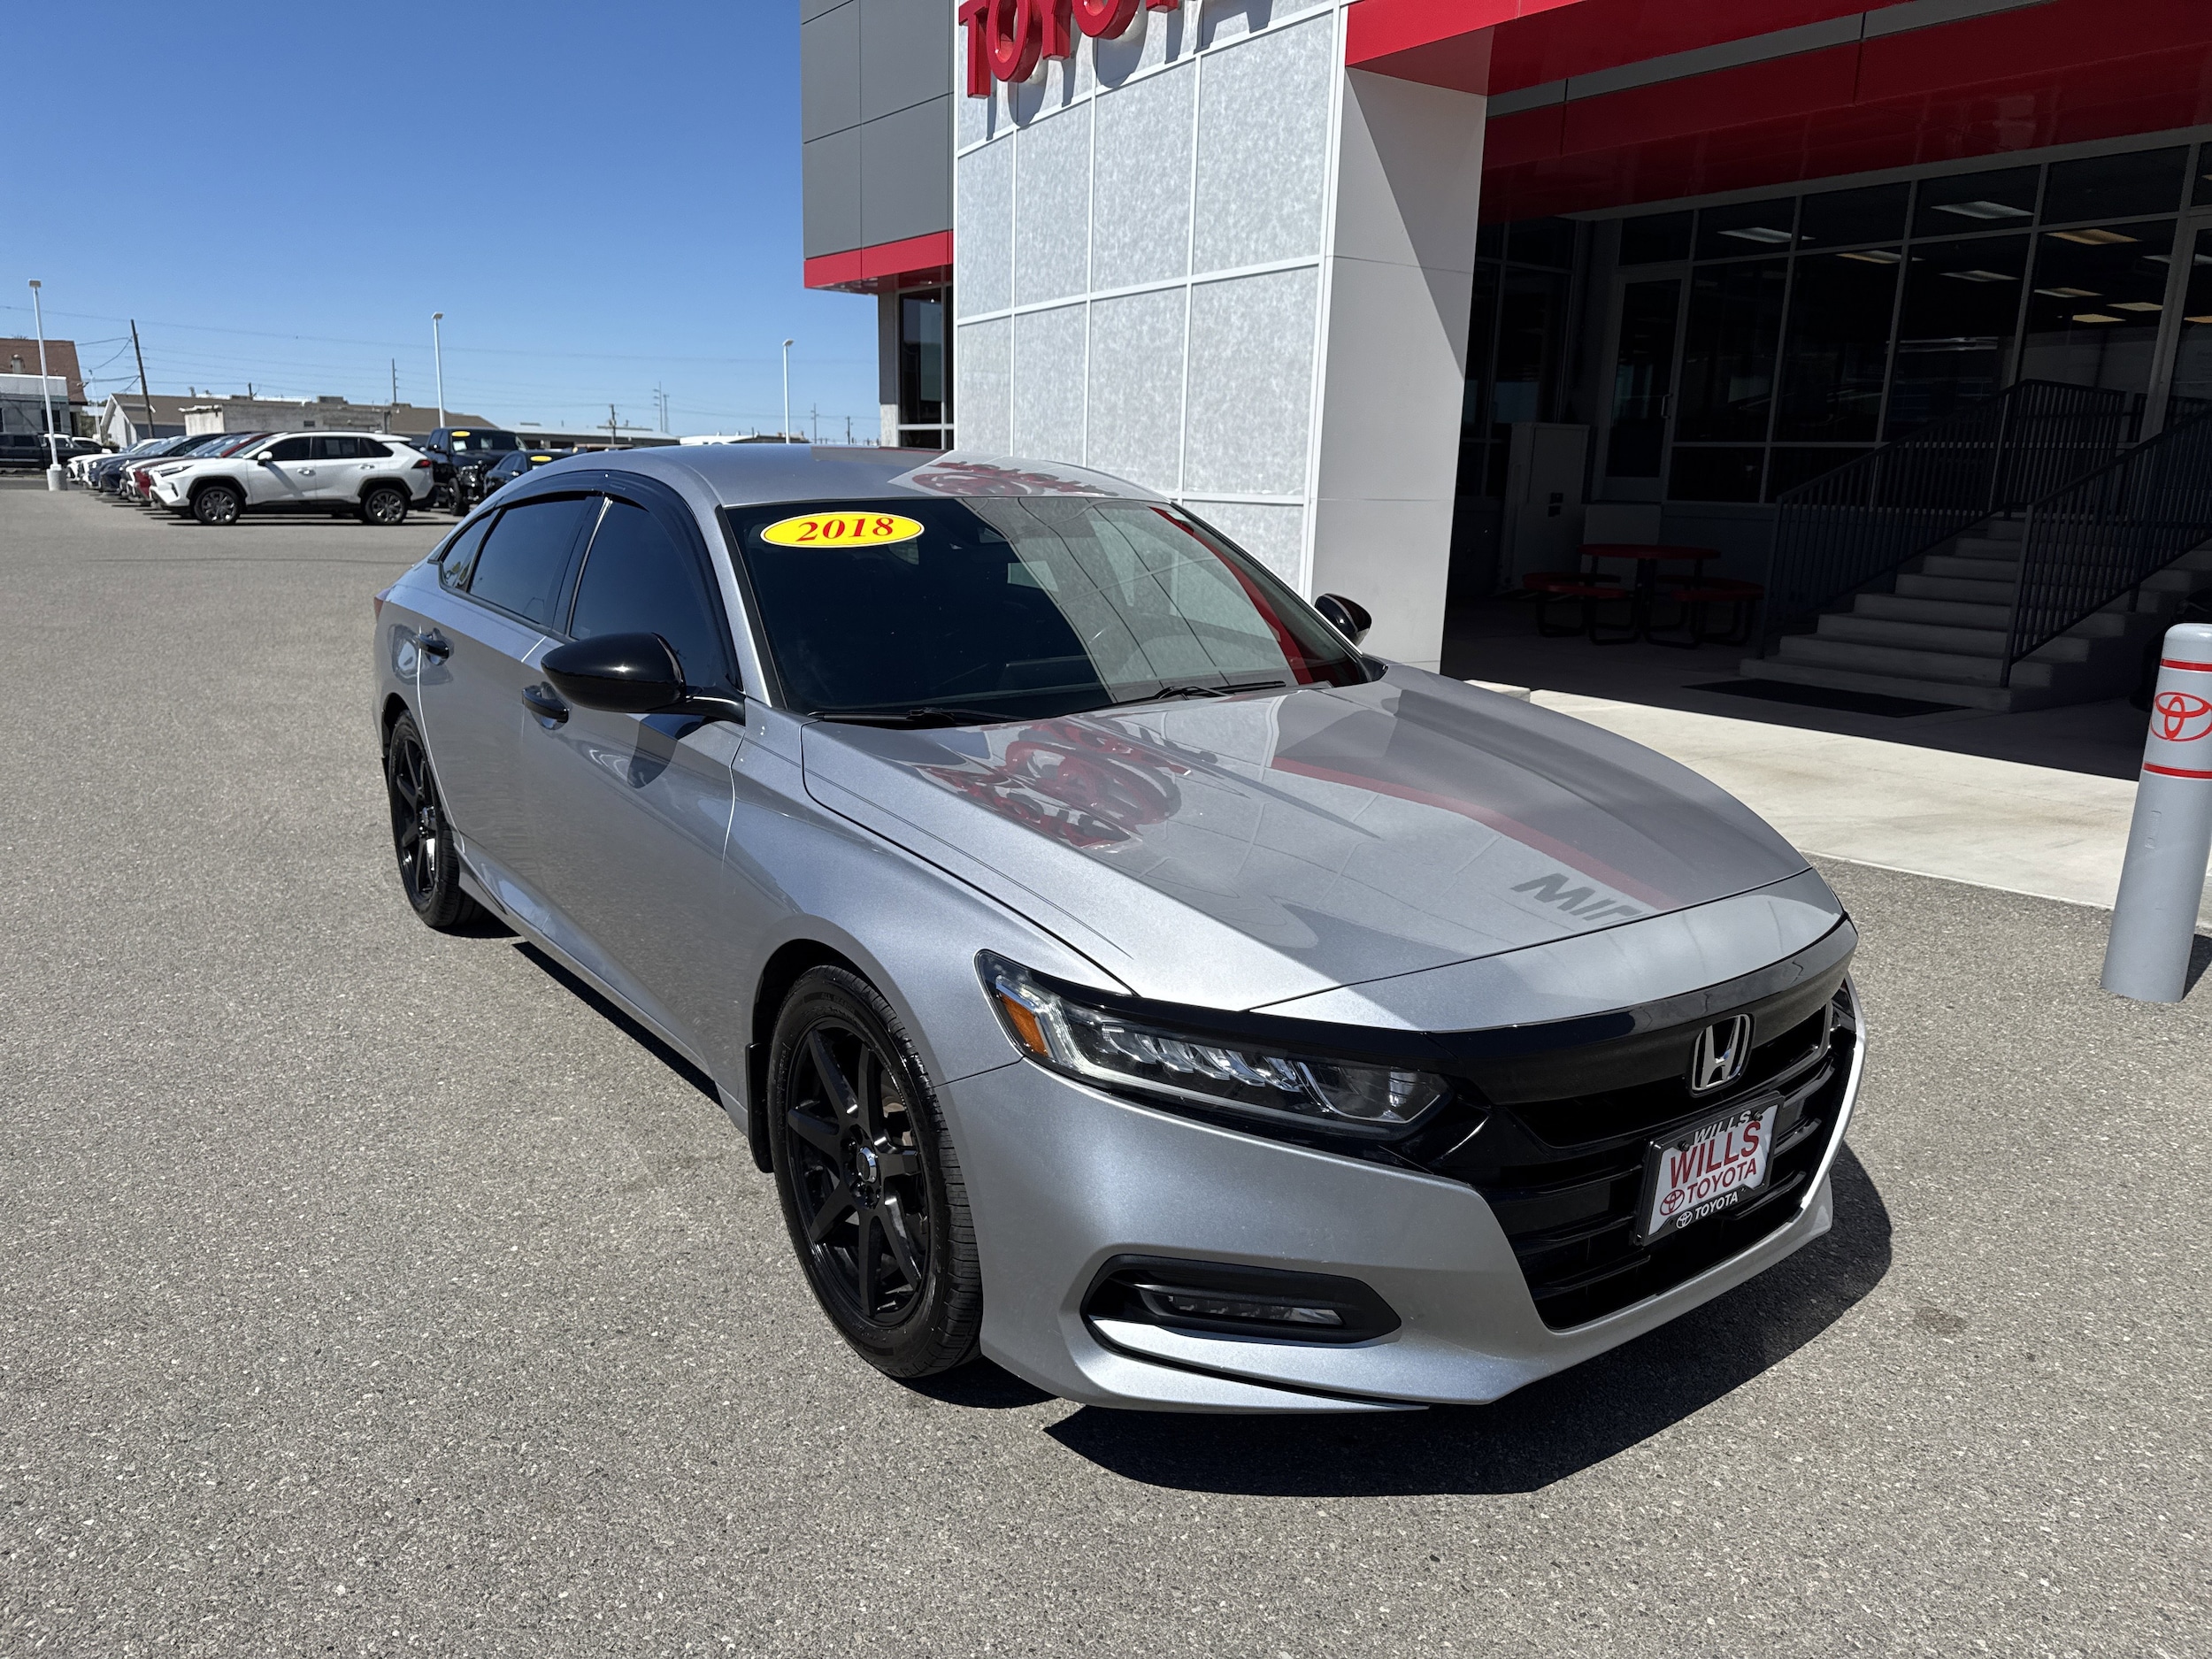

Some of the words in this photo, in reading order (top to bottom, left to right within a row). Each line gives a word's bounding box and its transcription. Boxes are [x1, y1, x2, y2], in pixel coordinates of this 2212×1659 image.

[795, 518, 894, 541] 2018
[1694, 1110, 1751, 1145] WILLS
[1670, 1120, 1761, 1189] WILLS
[1686, 1158, 1757, 1204] TOYOTA
[1694, 1192, 1739, 1220] TOYOTA
